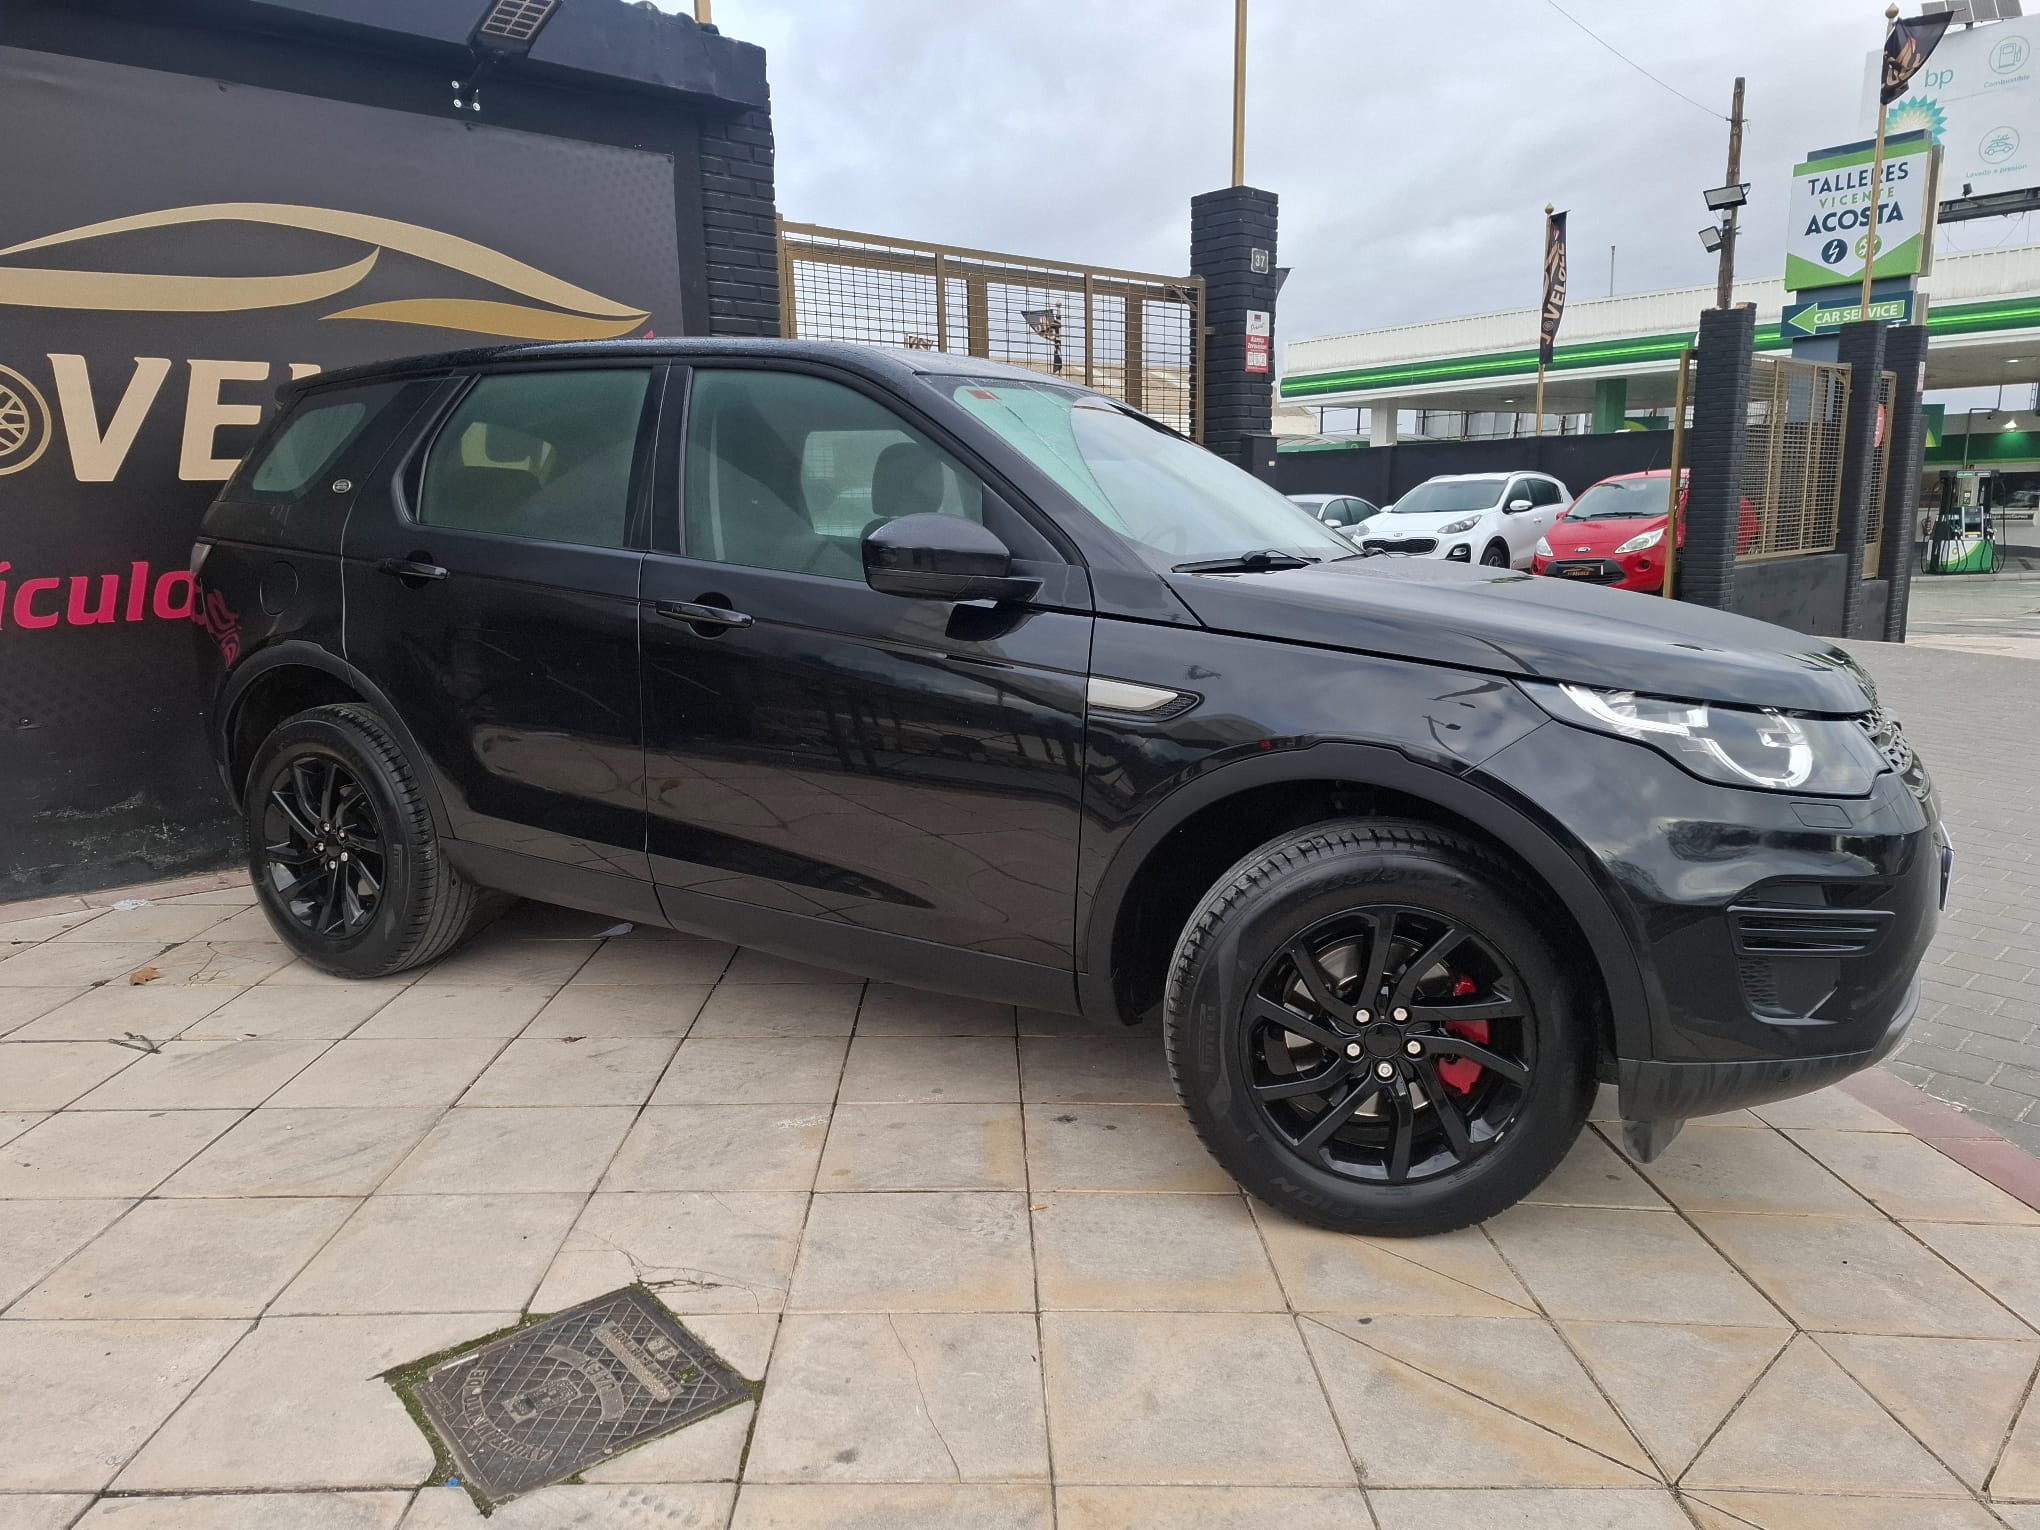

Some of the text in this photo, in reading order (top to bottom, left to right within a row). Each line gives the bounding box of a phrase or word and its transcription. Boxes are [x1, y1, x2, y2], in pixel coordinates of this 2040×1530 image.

[1924, 68, 1954, 89] bp
[1804, 200, 1904, 236] ACOSTA
[1255, 254, 1266, 268] 37
[1814, 311, 1840, 324] CAR
